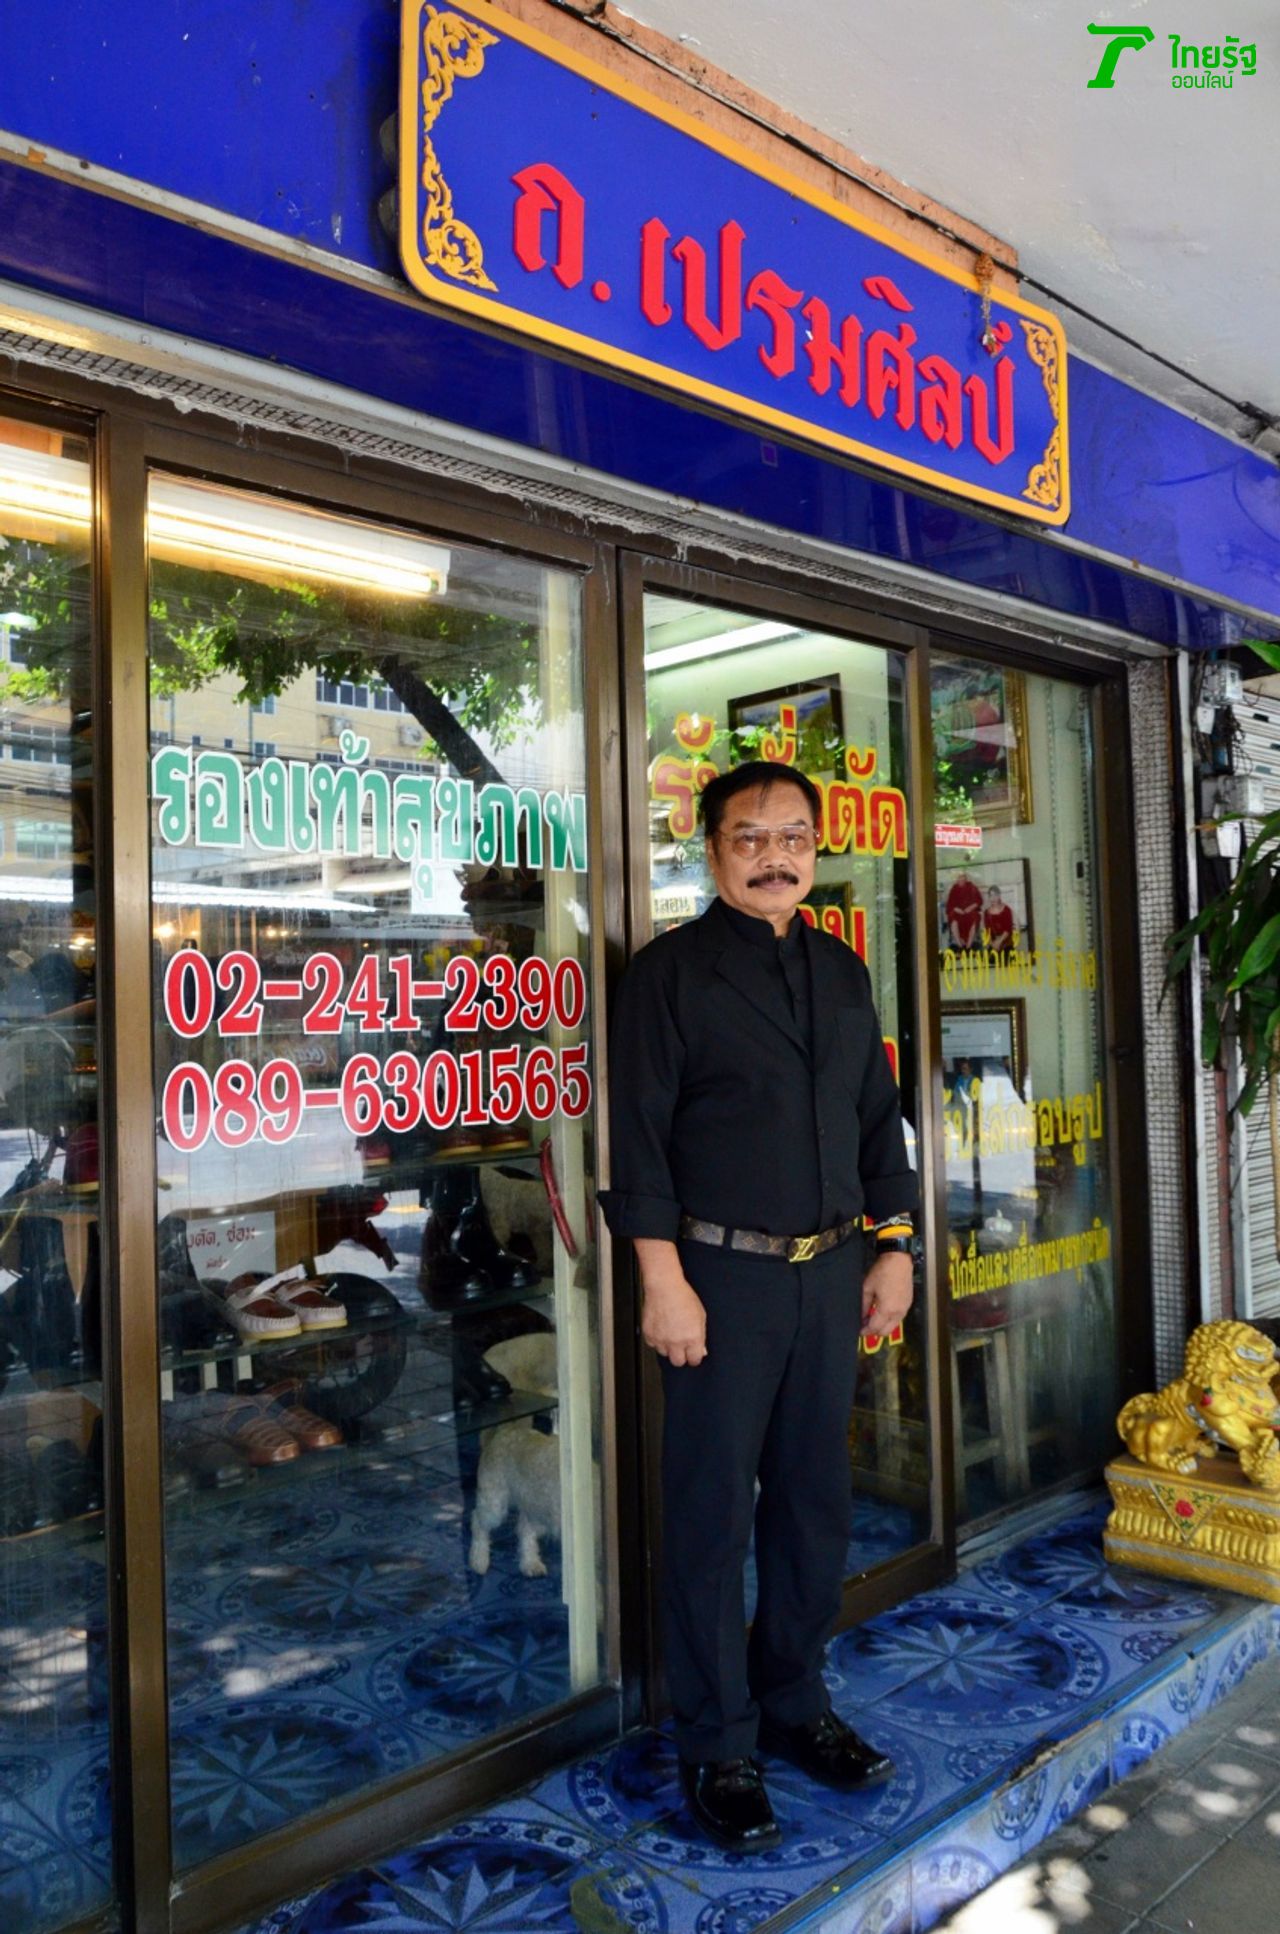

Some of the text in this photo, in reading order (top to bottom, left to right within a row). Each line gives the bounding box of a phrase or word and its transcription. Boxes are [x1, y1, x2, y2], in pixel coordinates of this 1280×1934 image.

[152, 729, 589, 900] รองเท้าสุขภาพ
[163, 948, 587, 1038] 02-241-2390
[162, 1042, 592, 1152] 089-6301565
